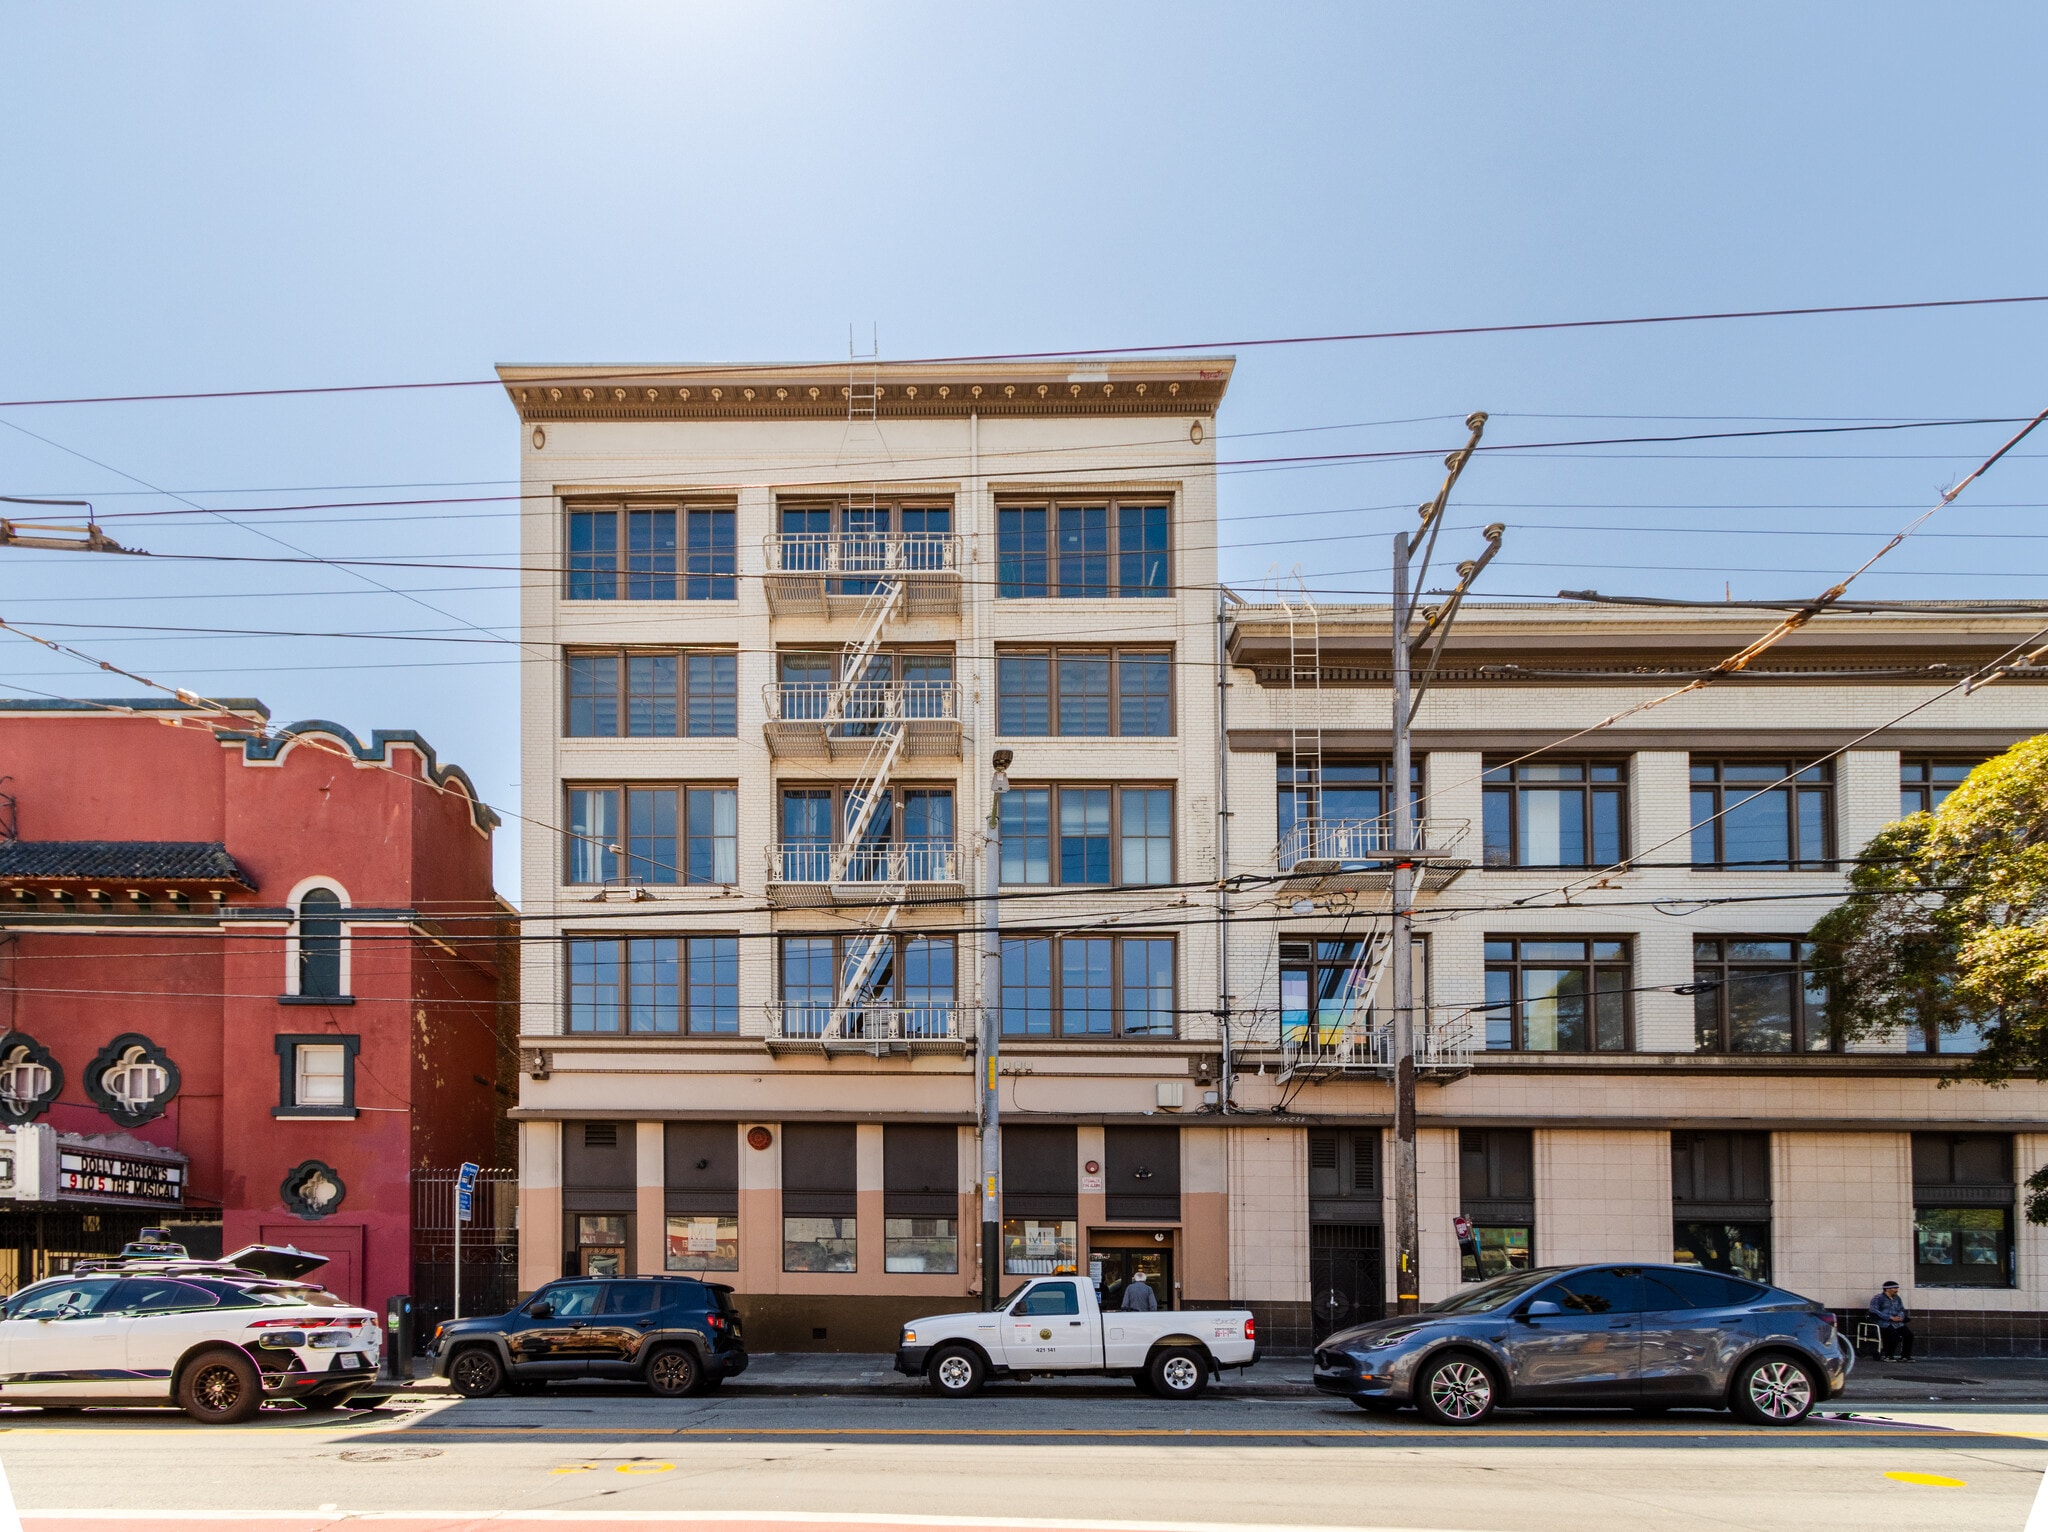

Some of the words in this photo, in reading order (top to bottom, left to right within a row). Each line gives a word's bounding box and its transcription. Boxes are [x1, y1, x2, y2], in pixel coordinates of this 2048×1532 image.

[82, 1157, 114, 1174] DOLLY
[120, 1162, 168, 1181] PARTON'S
[70, 1174, 77, 1188] 9
[81, 1174, 95, 1190] TO
[98, 1176, 105, 1191] 5
[112, 1178, 130, 1193] THE
[134, 1182, 175, 1198] MUSICAL
